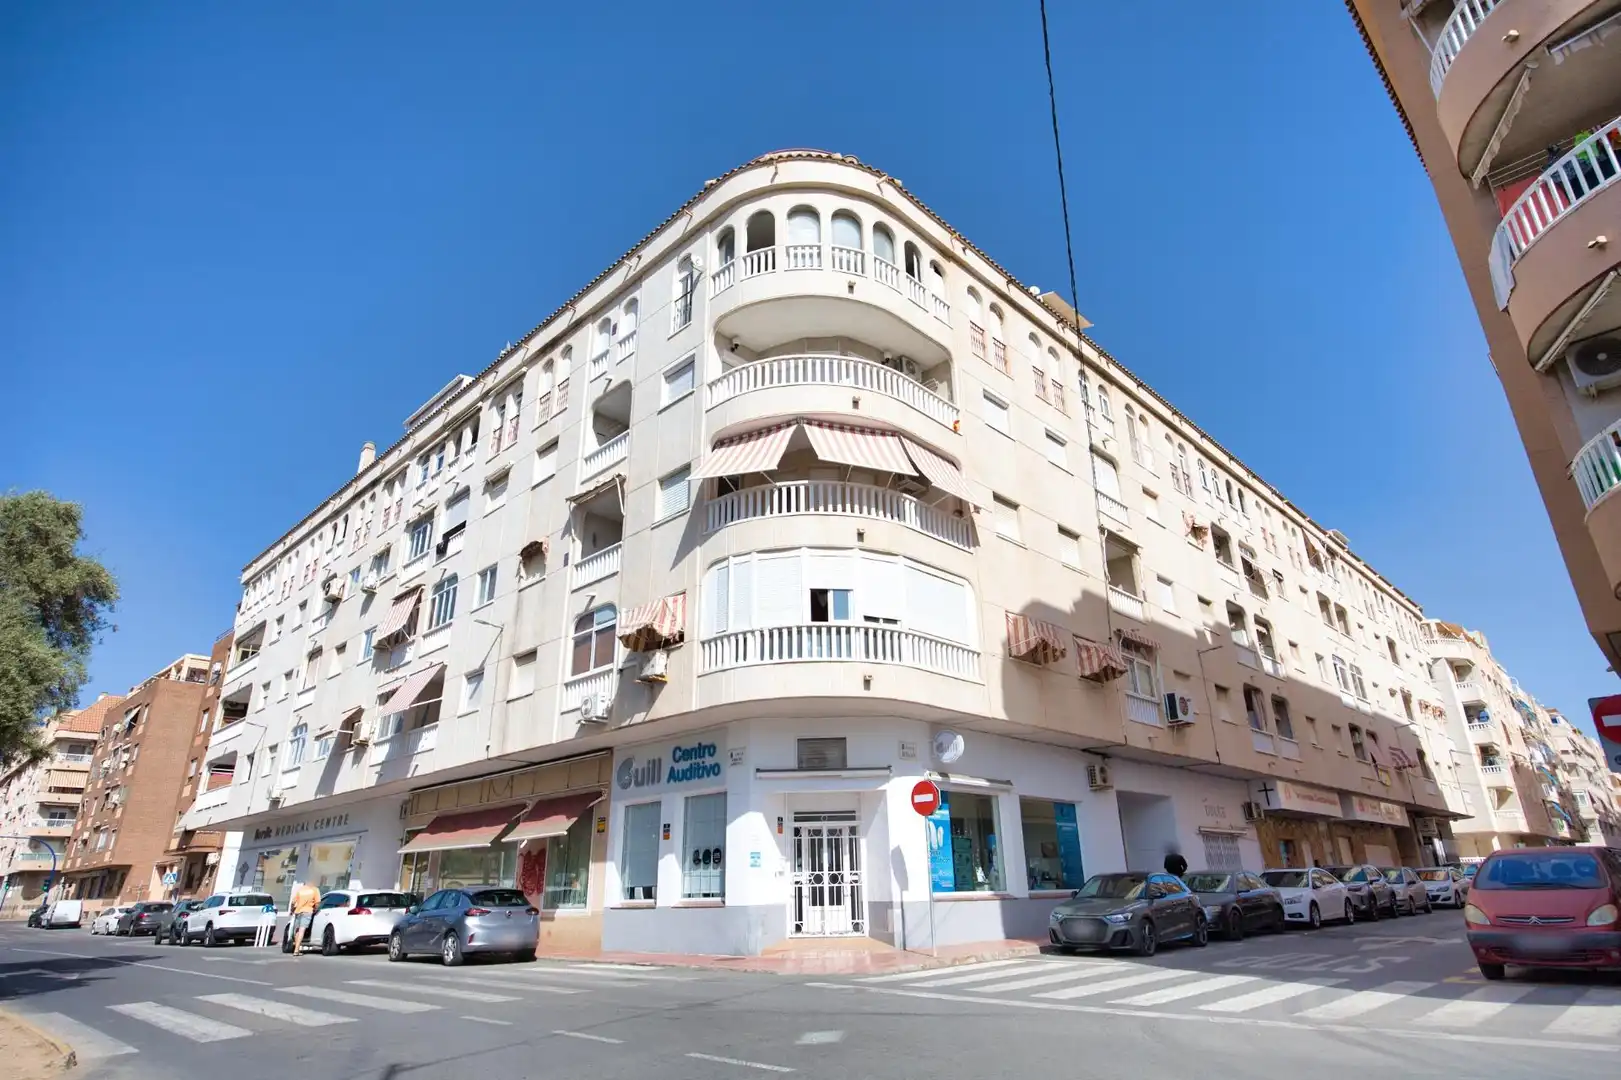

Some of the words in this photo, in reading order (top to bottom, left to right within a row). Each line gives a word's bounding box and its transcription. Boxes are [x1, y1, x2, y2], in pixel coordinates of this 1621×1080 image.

[672, 742, 717, 763] Centro
[667, 761, 721, 784] Auditivo
[275, 821, 309, 837] MEDICAL
[313, 813, 349, 830] CENTRE
